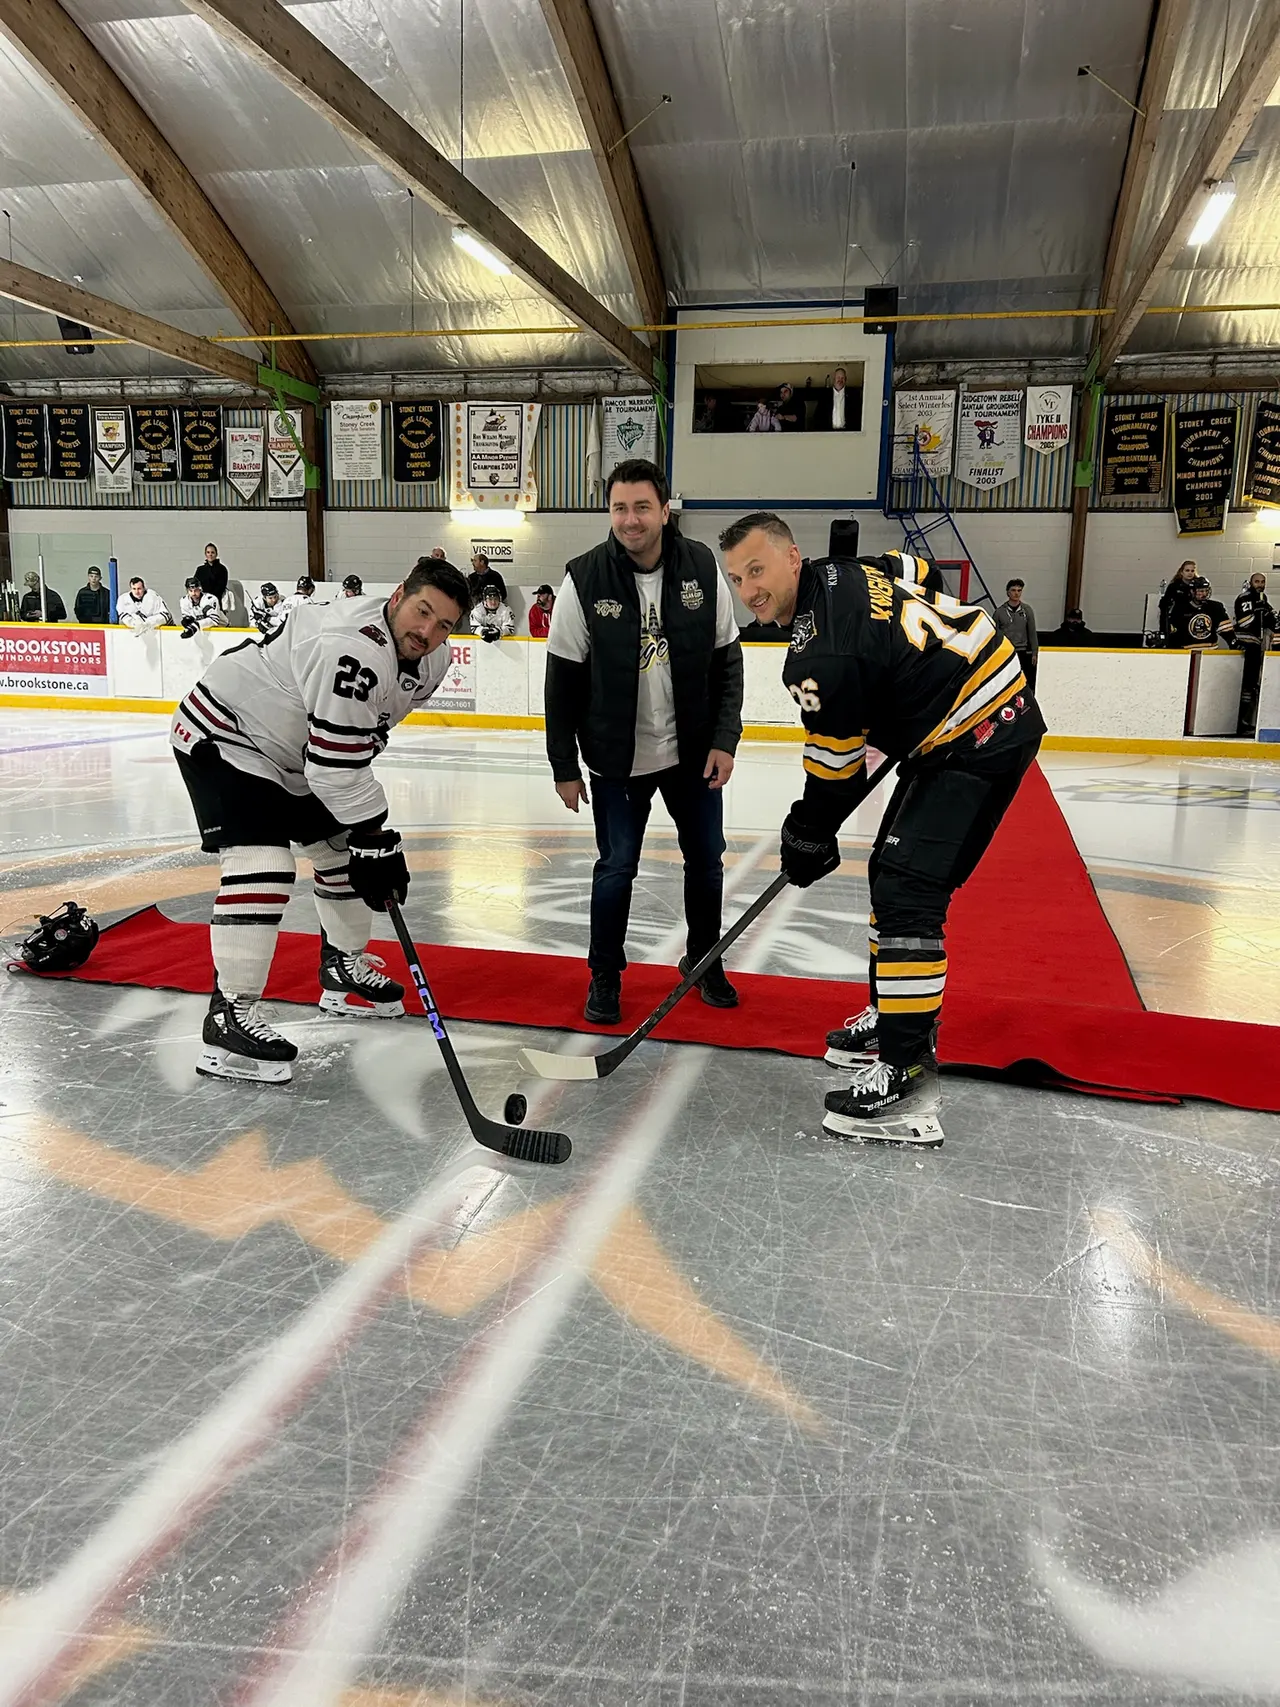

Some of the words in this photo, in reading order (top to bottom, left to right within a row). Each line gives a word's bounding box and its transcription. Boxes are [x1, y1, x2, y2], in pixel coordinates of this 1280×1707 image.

[919, 393, 945, 401] Annual
[963, 394, 997, 403] RIDGETOWN
[617, 405, 656, 413] TOURNAMENT
[919, 401, 953, 409] Winterfest
[918, 409, 933, 417] 2003
[975, 410, 1019, 418] TOURNAMENT
[1115, 413, 1136, 422] STONEY
[1140, 411, 1158, 420] CREEK
[1036, 414, 1054, 424] TYKE
[1179, 419, 1204, 429] STONEY
[1211, 416, 1233, 426] CREEK
[1027, 424, 1068, 440] CHAMPIONS
[1111, 422, 1150, 435] TOURNAMENT
[1181, 429, 1221, 450] TOURNAMENT
[1222, 436, 1231, 445] OF
[269, 441, 305, 450] CHAMPIOS
[1040, 441, 1055, 449] 2003
[1117, 442, 1150, 451] CHAMPIONS
[1204, 444, 1224, 452] ANNUAL
[1188, 453, 1225, 467] CHAMPIONS
[233, 462, 261, 471] BRANTFORD
[473, 462, 500, 470] CHAMPIONS
[1117, 466, 1148, 474] CHAMPIONS
[969, 467, 1004, 476] FINALIST
[1177, 471, 1196, 480] MINOR
[1198, 469, 1222, 479] BANTAM
[976, 477, 997, 485] 2003
[1124, 477, 1139, 485] 2002
[1186, 481, 1222, 491] CHAMPIONS
[1254, 485, 1272, 496] 2000
[1195, 493, 1214, 501] 2001
[473, 545, 512, 556] VISITORS
[0, 638, 101, 656] BROOKSTONE
[65, 656, 101, 664] DOORS
[333, 655, 378, 702] 23
[442, 686, 472, 694] Jumpstart
[349, 839, 404, 859] TRUE
[409, 963, 446, 1040] CCM
[860, 1093, 900, 1112] BAUER
